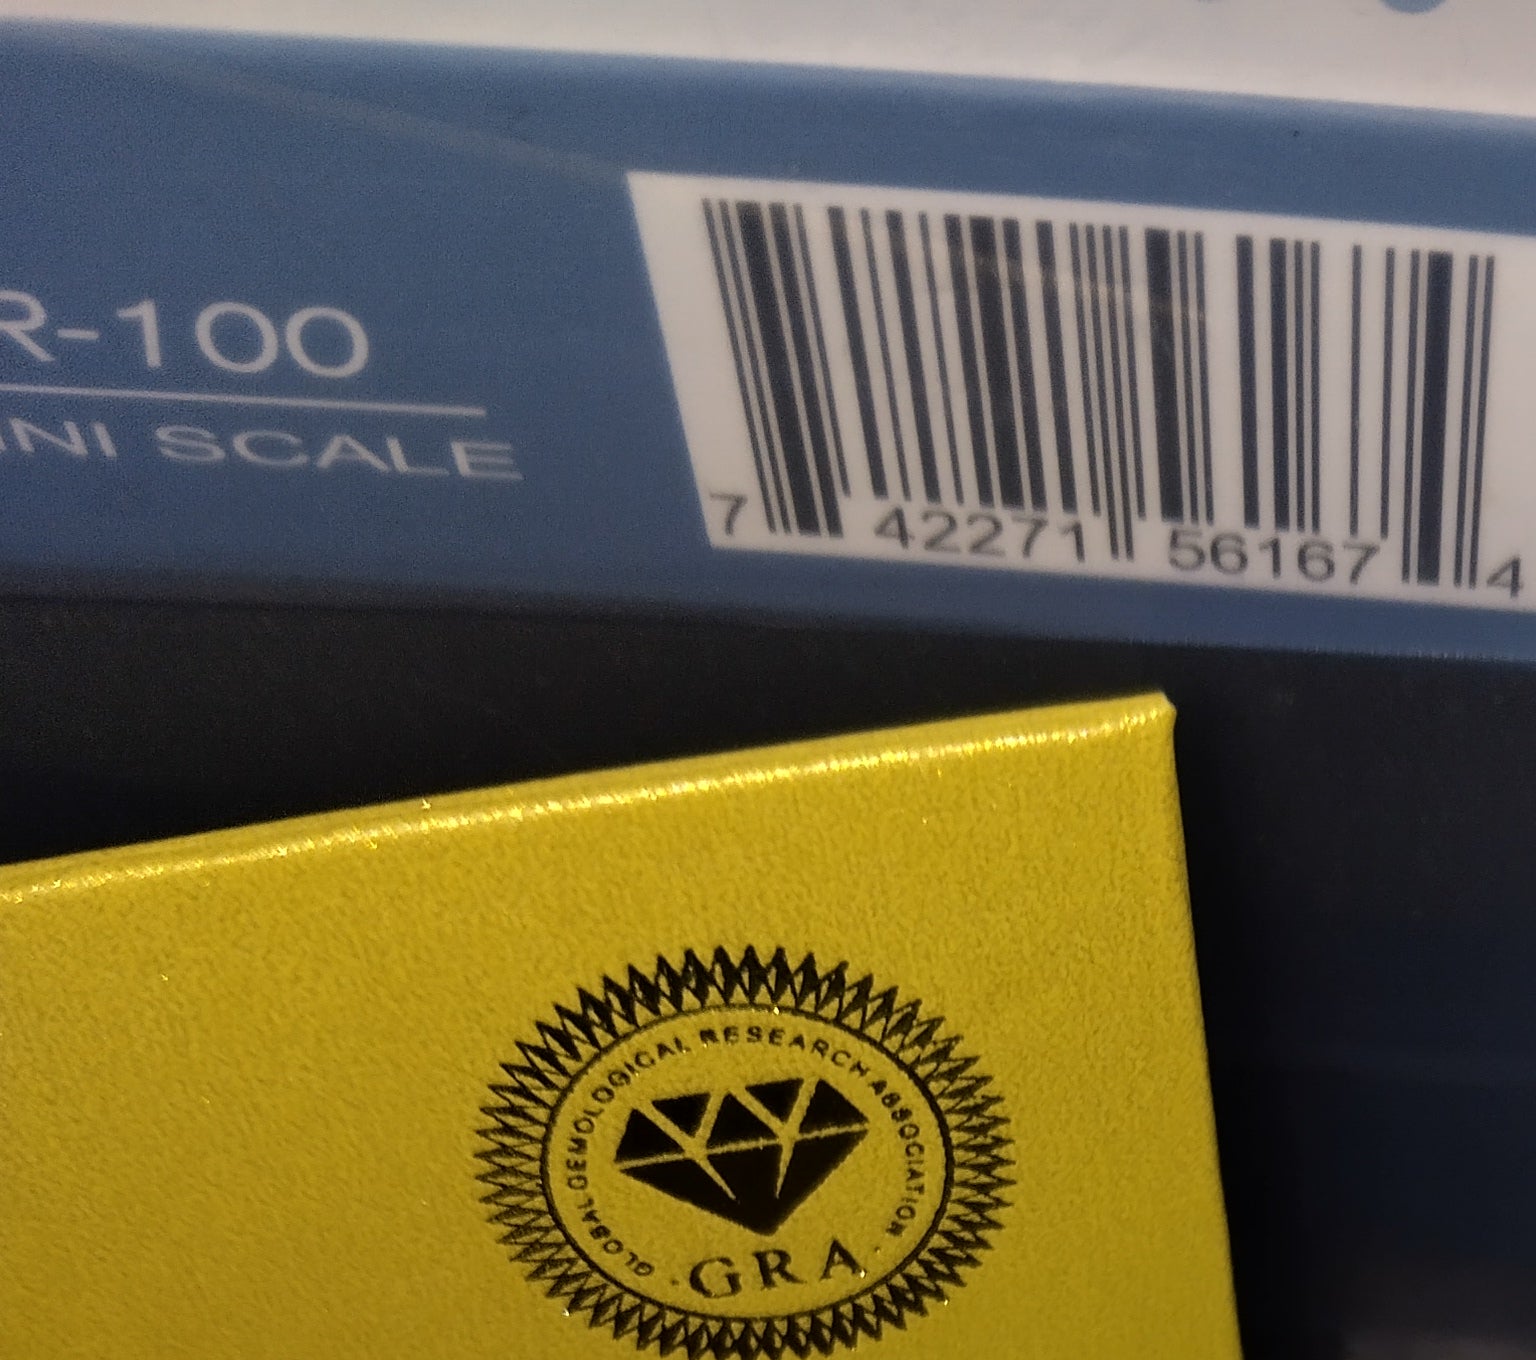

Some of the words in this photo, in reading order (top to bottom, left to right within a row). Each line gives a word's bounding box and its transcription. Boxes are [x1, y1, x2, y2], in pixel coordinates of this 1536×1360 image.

[0, 416, 118, 459] NI
[154, 424, 525, 481] SCALE
[709, 492, 749, 536] 7
[873, 506, 1085, 562] 42271
[1168, 528, 1381, 586] 56167
[1486, 553, 1525, 599] 4
[699, 1025, 870, 1078] RESEARCH
[565, 1036, 692, 1191] GEMOLOGICAL
[867, 1079, 926, 1237] ASSOCIATION
[576, 1193, 656, 1278] GLOBAL
[688, 1237, 868, 1299] GRA
